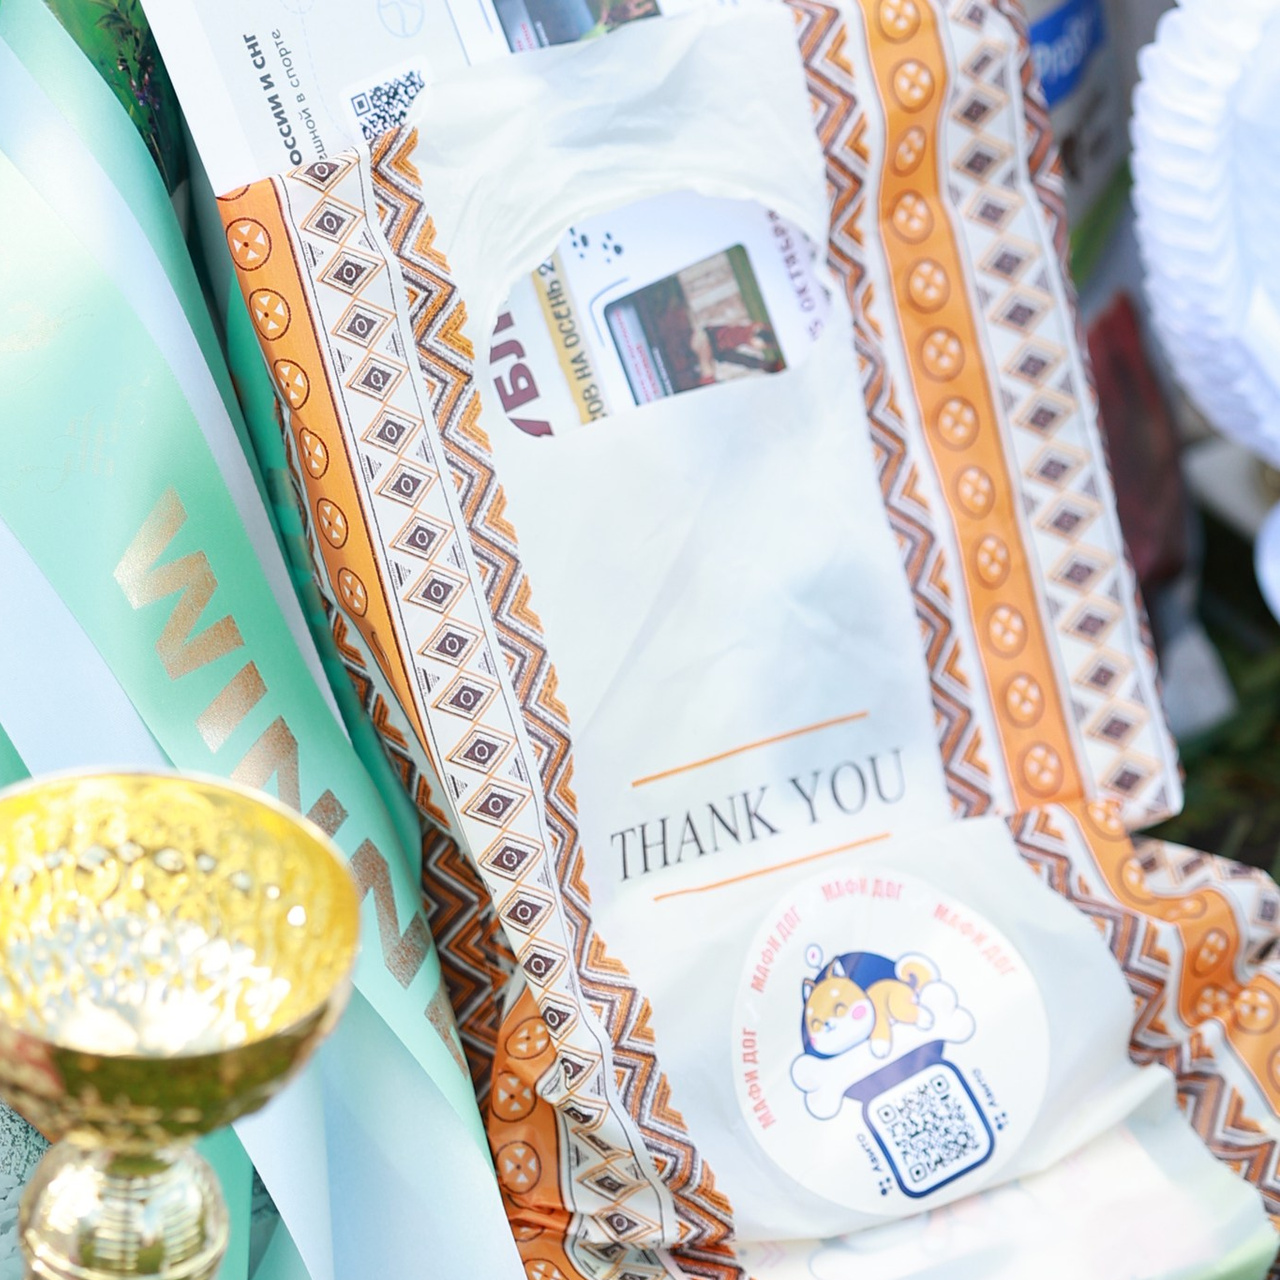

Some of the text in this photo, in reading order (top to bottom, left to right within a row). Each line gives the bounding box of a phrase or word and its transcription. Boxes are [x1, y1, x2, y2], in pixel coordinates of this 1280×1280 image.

[271, 27, 301, 89] спорте
[295, 92, 307, 104] в
[242, 33, 304, 167] ОССИИ И СНГ
[543, 281, 583, 351] ОСЕНЬ
[574, 357, 596, 384] НА
[609, 747, 908, 883] THANK YOU
[750, 904, 803, 994] МАФИ ДОГ
[741, 1026, 778, 1131] МАФИ ДОГ
